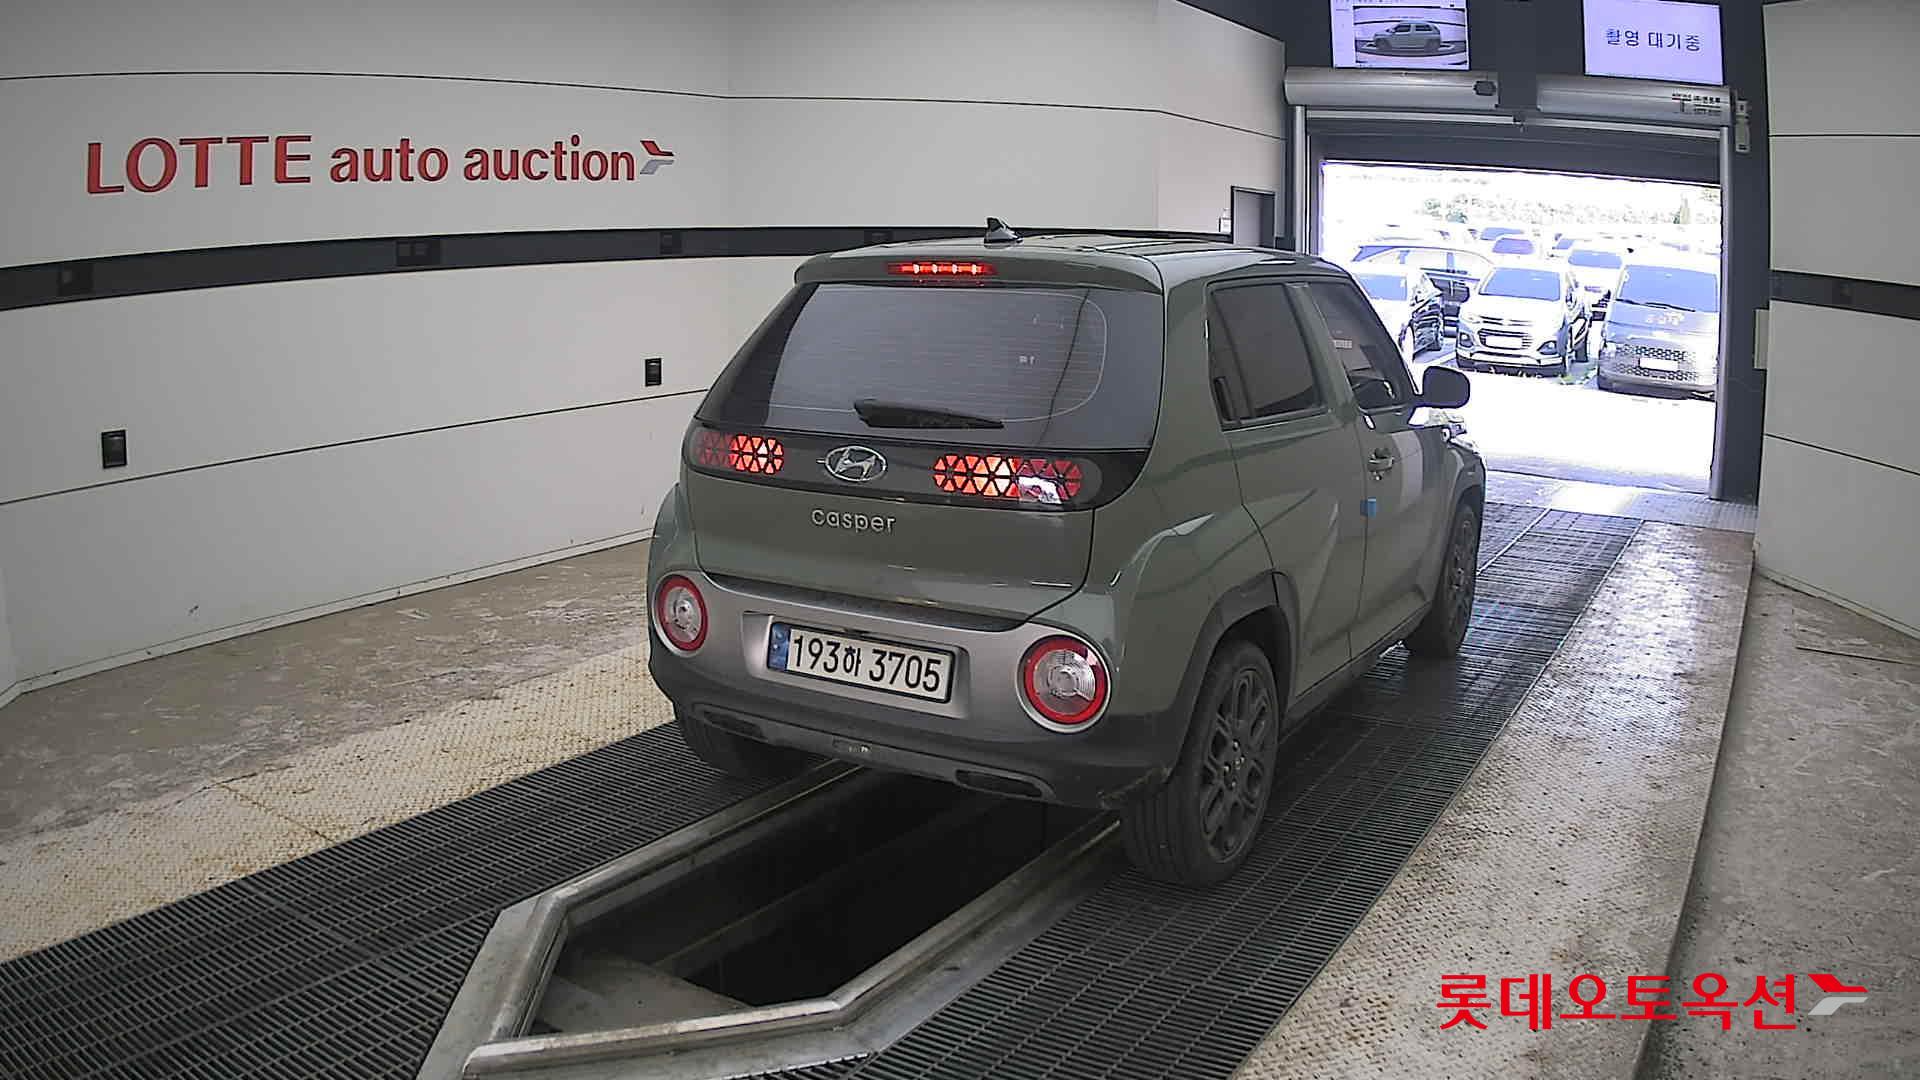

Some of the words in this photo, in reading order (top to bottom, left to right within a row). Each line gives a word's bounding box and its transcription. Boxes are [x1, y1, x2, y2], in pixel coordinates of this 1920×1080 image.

[1606, 28, 1640, 47] 촬영
[87, 134, 312, 194] LOTTE
[330, 138, 449, 183] auto
[463, 134, 636, 181] auction
[812, 509, 897, 534] casper
